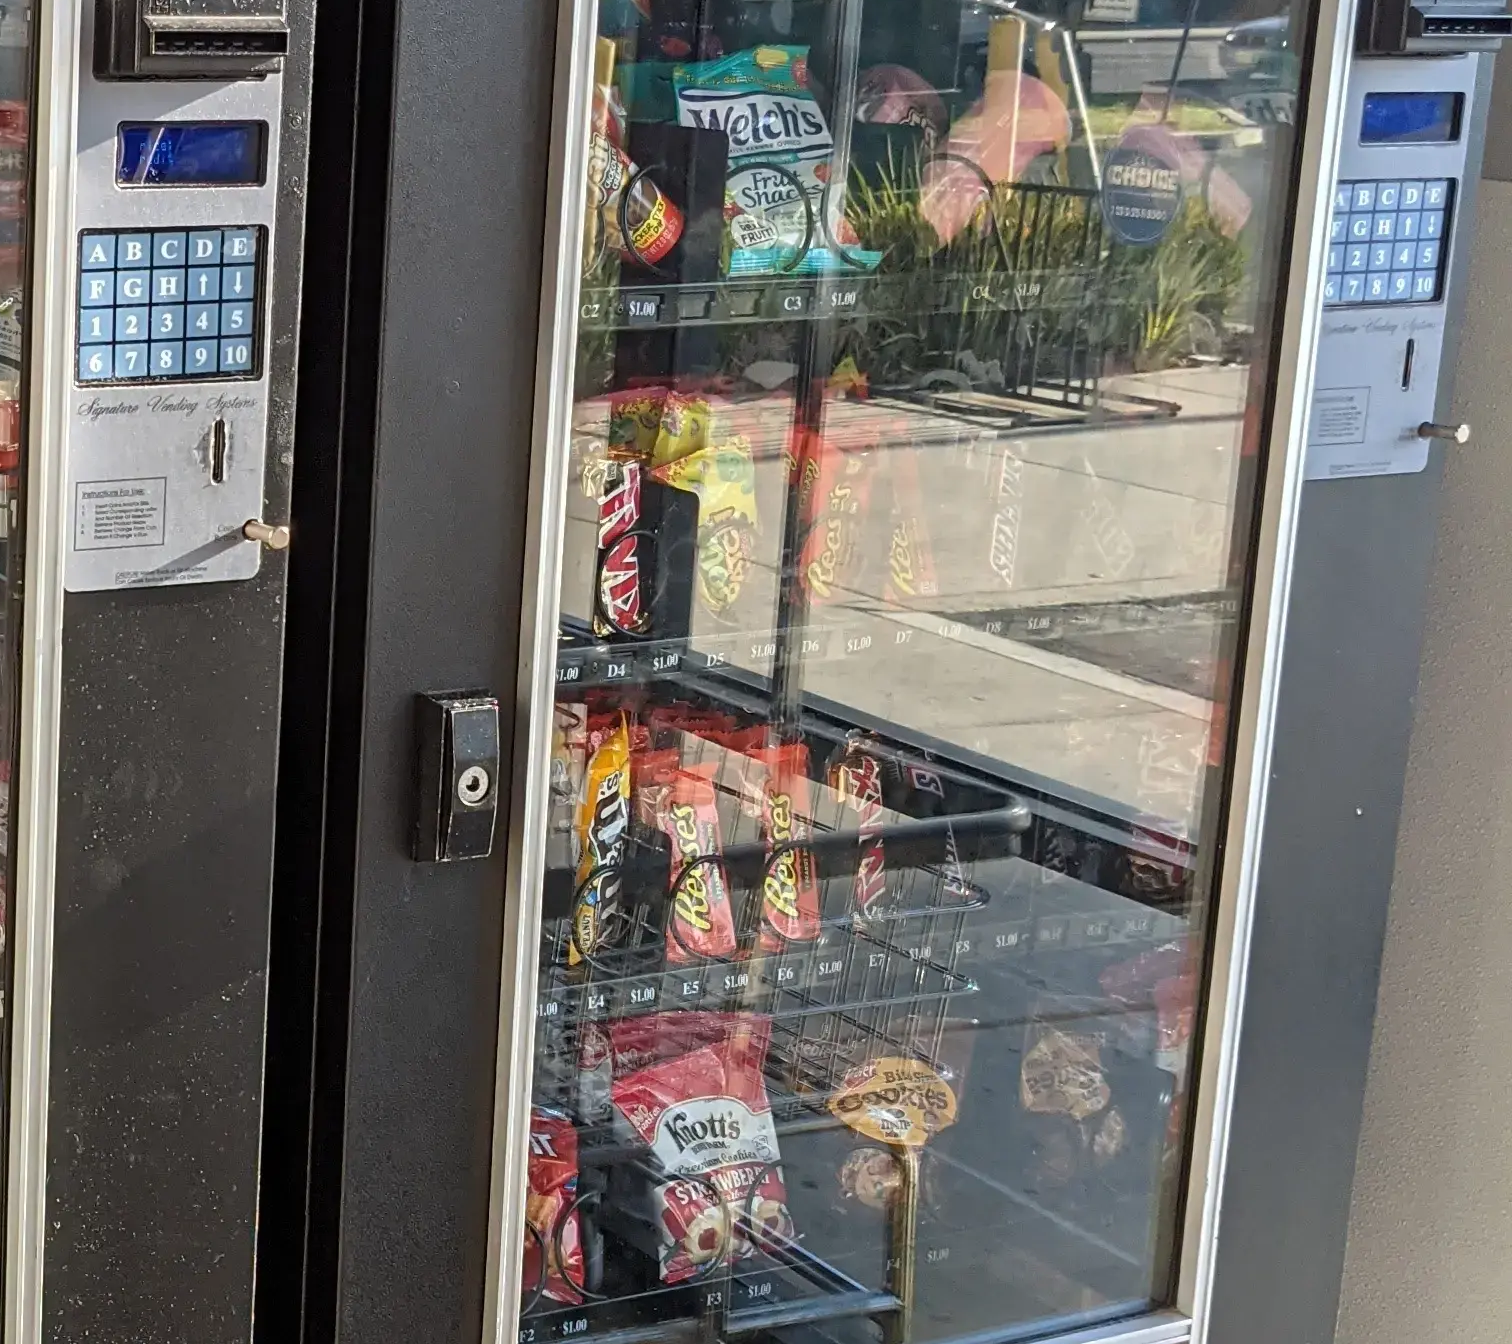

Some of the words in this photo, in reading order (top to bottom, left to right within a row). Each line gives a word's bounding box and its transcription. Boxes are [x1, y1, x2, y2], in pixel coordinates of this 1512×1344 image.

[1358, 190, 1370, 206] B
[1381, 189, 1395, 205] C
[1405, 188, 1418, 204] D
[1430, 188, 1442, 203] E
[1353, 220, 1367, 236] G
[1377, 219, 1391, 235] H
[89, 243, 107, 263] A
[126, 242, 142, 260] B
[161, 240, 178, 259] C
[195, 239, 213, 257] D
[231, 238, 247, 256] E
[1423, 247, 1433, 263] 5
[1351, 250, 1361, 266] 2
[1375, 249, 1386, 265] 3
[1399, 248, 1409, 264] 4
[89, 279, 106, 299] F
[124, 279, 142, 297] G
[159, 276, 178, 296] H
[1349, 280, 1359, 296] 7
[1372, 279, 1382, 295] 8
[1396, 278, 1406, 293] 9
[1416, 277, 1433, 293] 10
[784, 296, 802, 311] C3
[831, 291, 857, 307] $1.00
[580, 303, 600, 318] C2
[629, 301, 656, 317] $1.00
[91, 317, 101, 335] 1
[125, 315, 138, 334] 2
[161, 313, 173, 332] 3
[196, 311, 208, 330] 4
[231, 310, 244, 328] 5
[89, 352, 102, 372] 6
[125, 351, 138, 370] 7
[160, 350, 173, 368] 8
[195, 348, 207, 366] 9
[224, 345, 247, 364] 10
[76, 397, 139, 421] Signature
[147, 394, 199, 416] Vending
[847, 636, 872, 652] $1.00
[895, 629, 913, 645] D7
[751, 643, 775, 658] $1.00
[801, 640, 819, 654] D6
[653, 654, 678, 670] $1.00
[706, 652, 725, 667] D5
[607, 663, 626, 678] D4
[818, 960, 842, 976] $1.00
[869, 953, 885, 968] E7
[724, 973, 749, 989] $1.00
[777, 966, 794, 981] E6
[630, 987, 655, 1003] $1.00
[682, 980, 700, 995] E5
[588, 994, 605, 1010] E4
[664, 1111, 742, 1154] Knott's
[747, 1282, 772, 1298] $1.00
[707, 1293, 722, 1307] F3
[562, 1318, 588, 1336] $1.00
